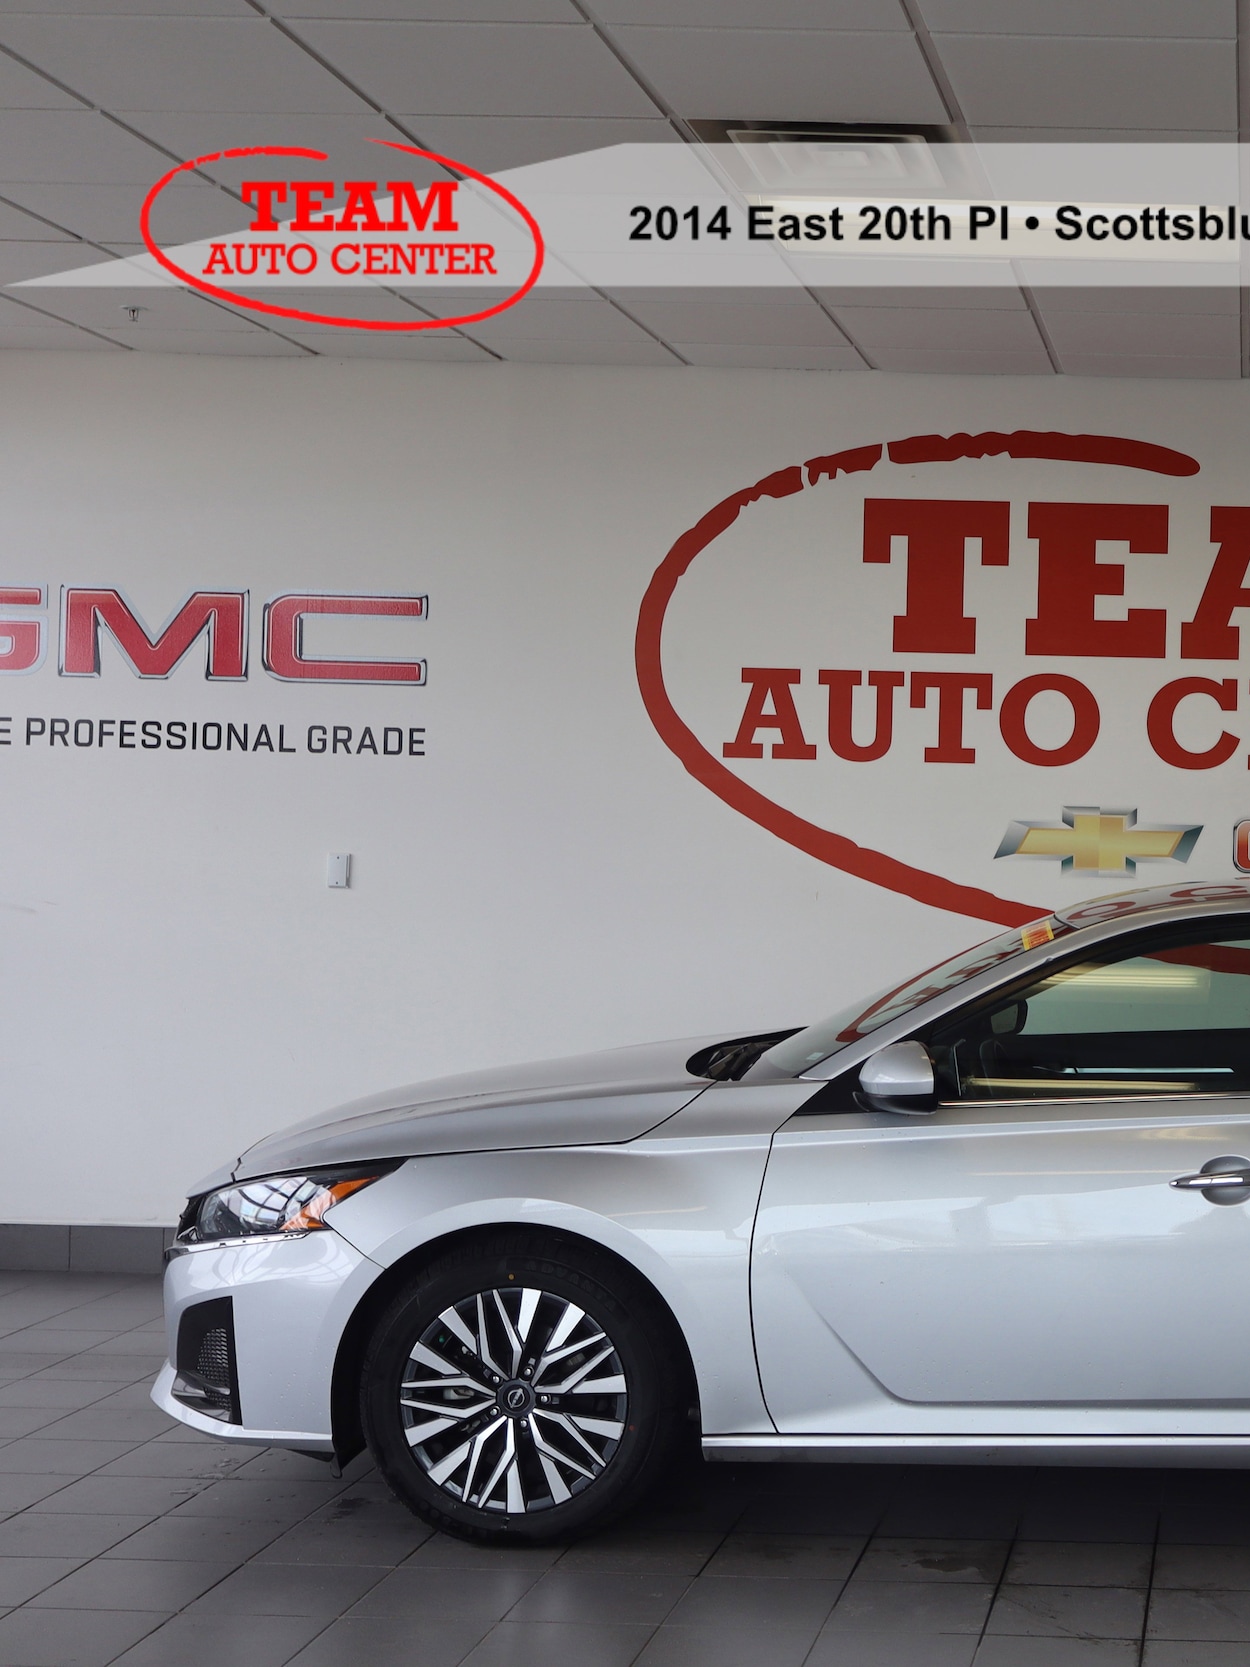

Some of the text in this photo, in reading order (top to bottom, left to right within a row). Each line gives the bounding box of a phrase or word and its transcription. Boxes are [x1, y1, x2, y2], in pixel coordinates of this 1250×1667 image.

[25, 717, 297, 753] PROFESSIONAL
[307, 725, 426, 756] GRADE
[723, 668, 1101, 766] AUTO
